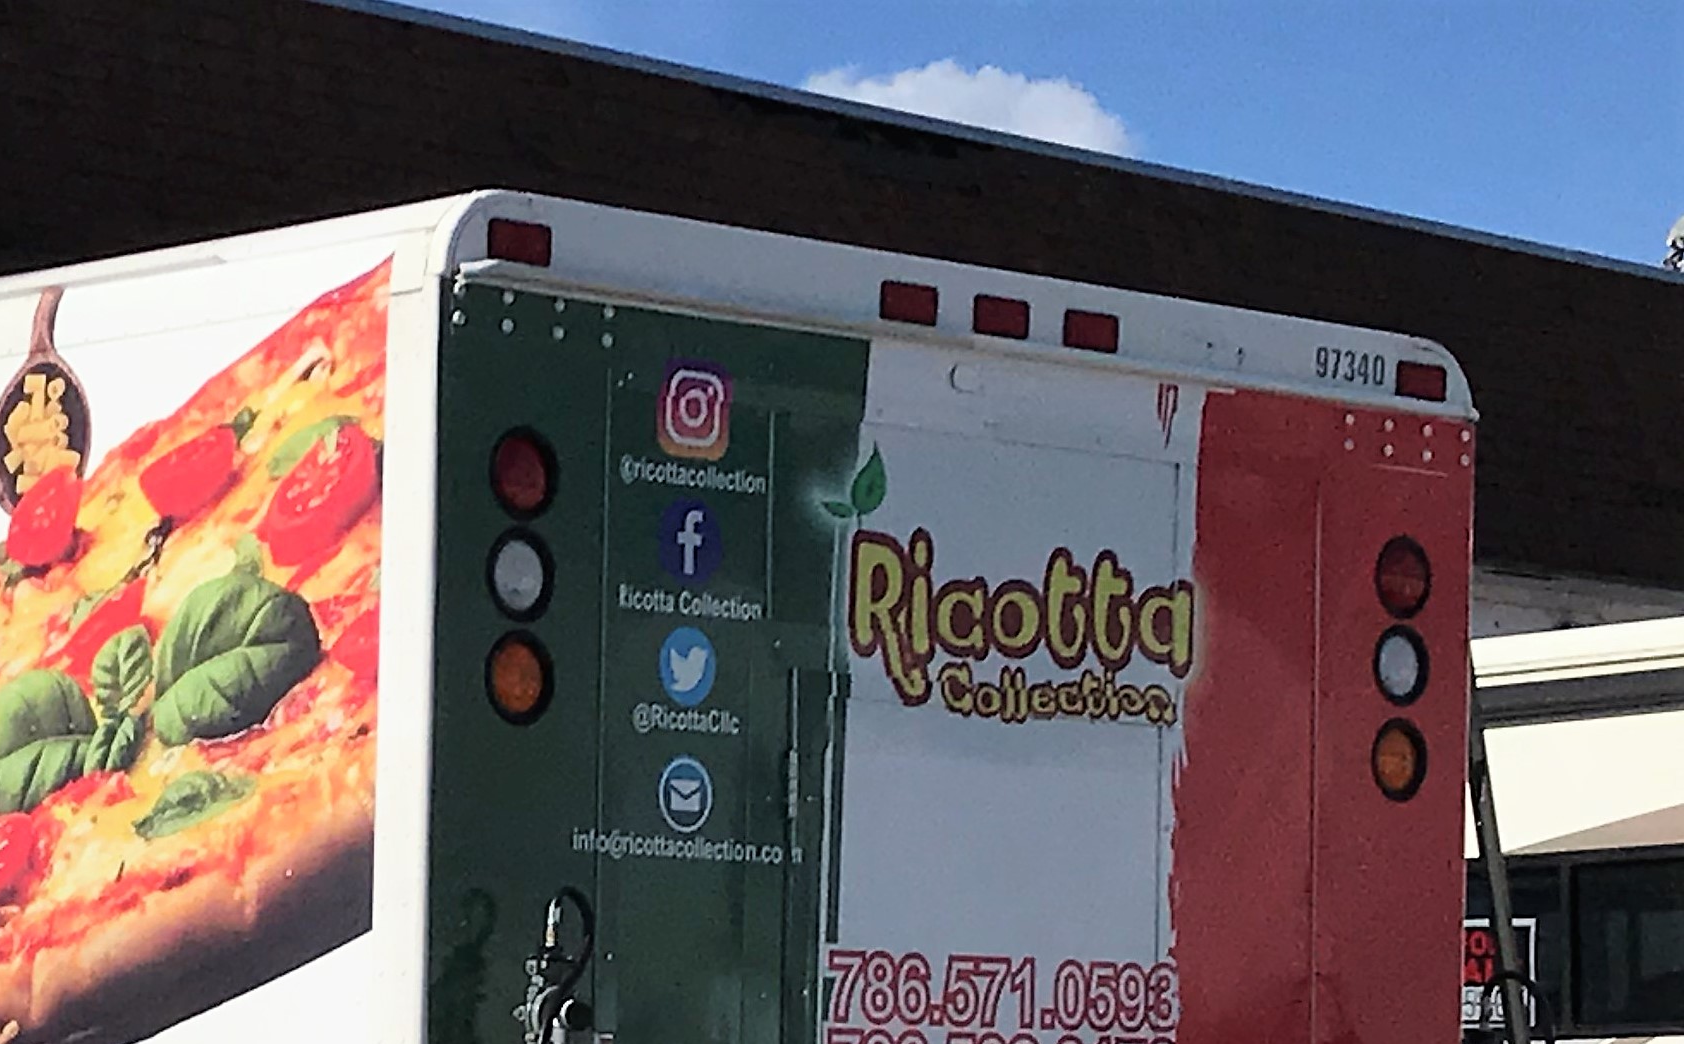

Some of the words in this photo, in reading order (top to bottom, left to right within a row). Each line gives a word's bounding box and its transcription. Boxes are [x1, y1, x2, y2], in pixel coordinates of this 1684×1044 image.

[1316, 346, 1386, 386] 97340
[619, 453, 767, 495] @ricottacollection
[618, 583, 674, 614] Ricotta
[678, 589, 763, 621] Collection
[848, 527, 1196, 707] Ricotta
[937, 662, 1178, 725] Collection
[827, 950, 1180, 1034] 786.571.0593
